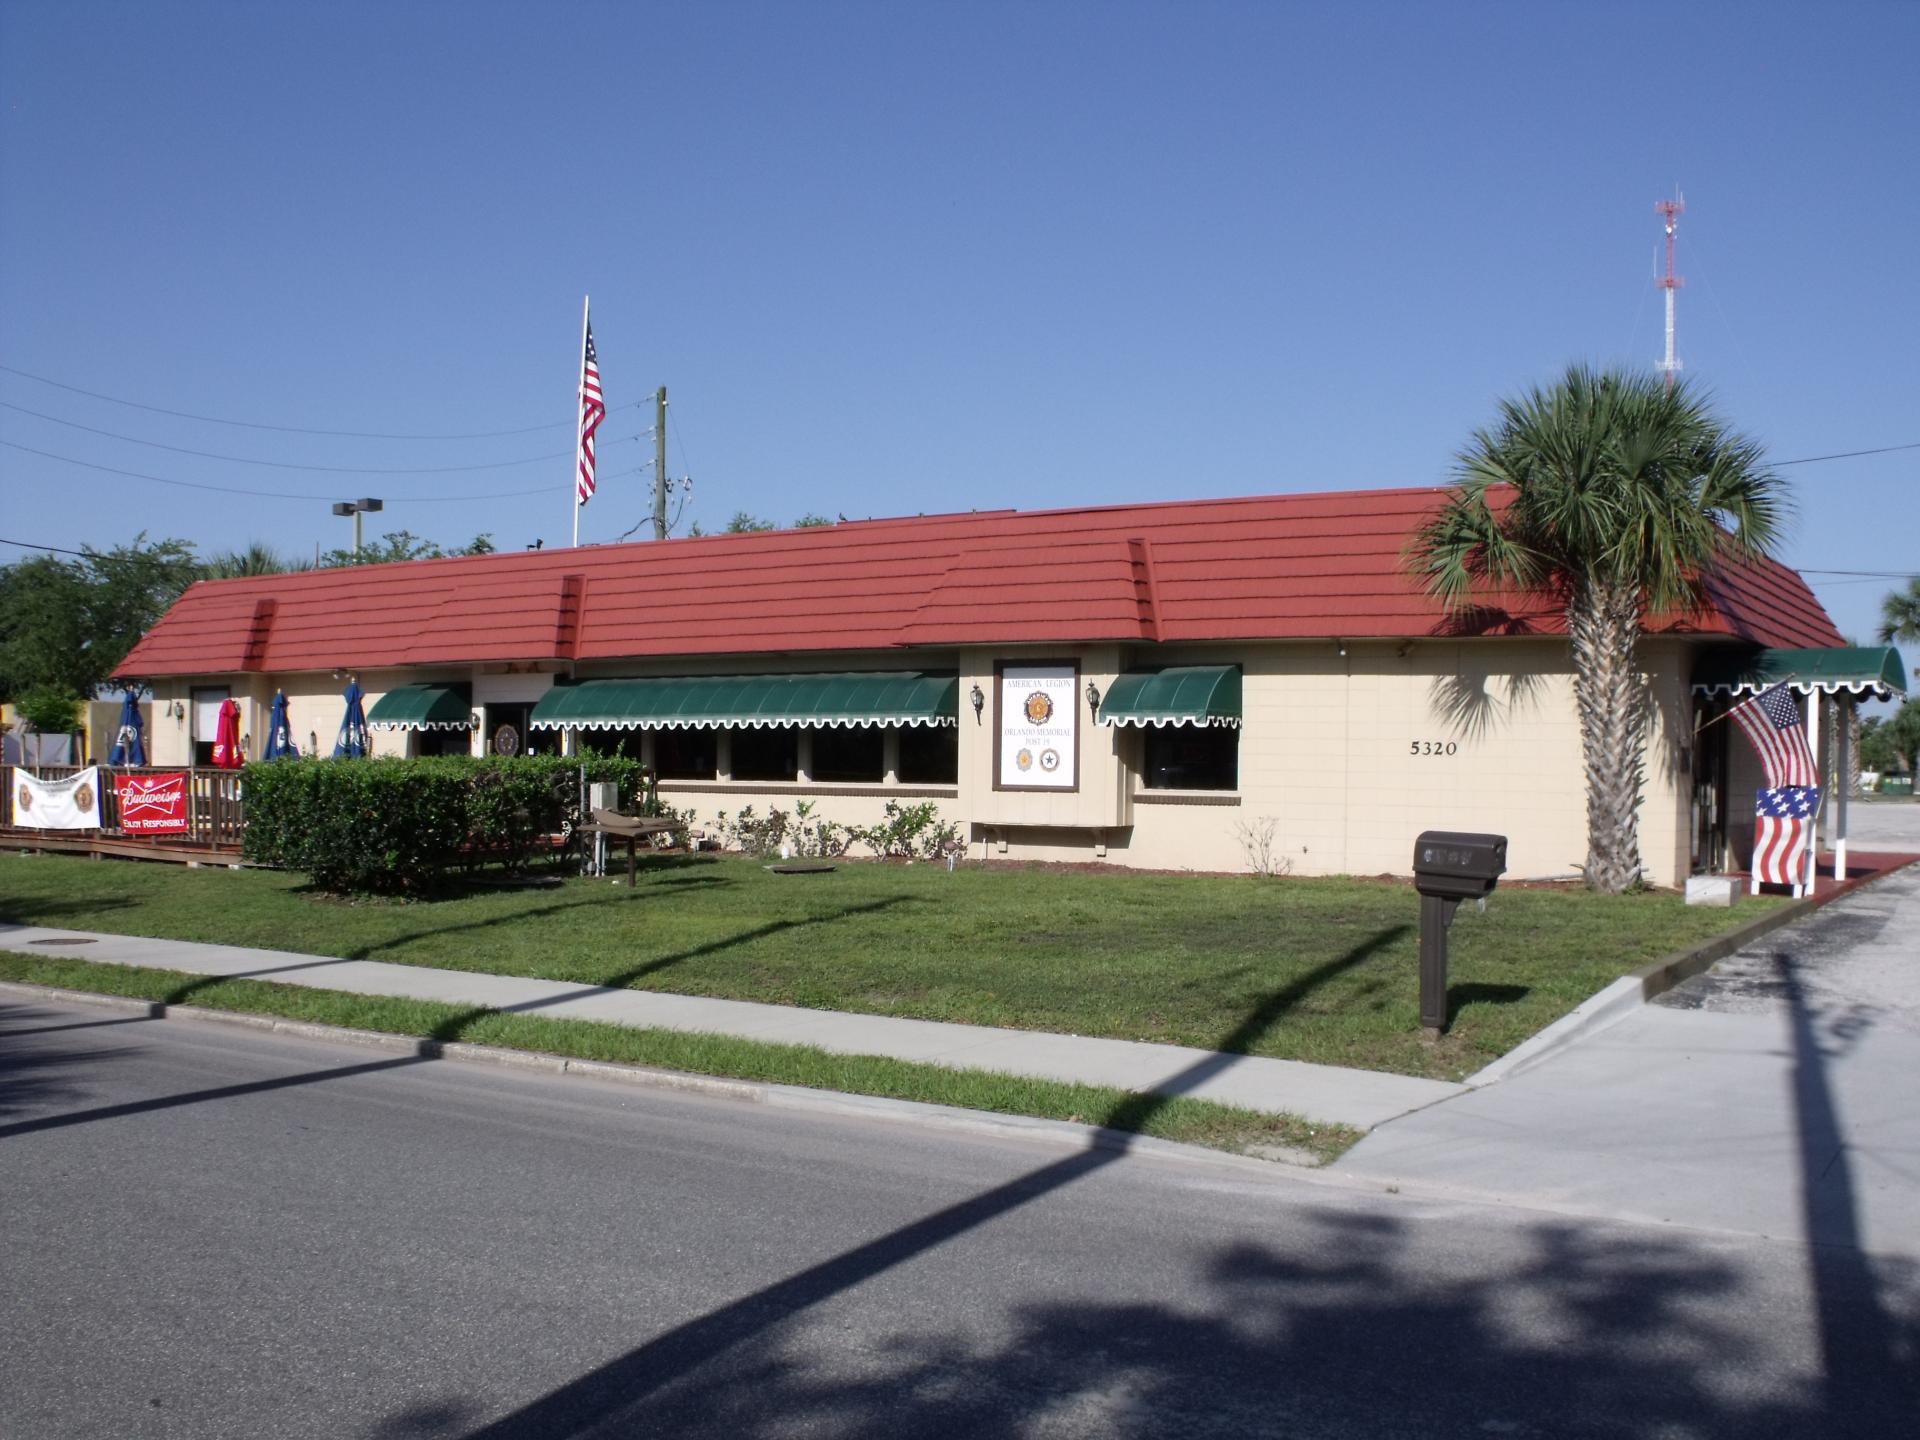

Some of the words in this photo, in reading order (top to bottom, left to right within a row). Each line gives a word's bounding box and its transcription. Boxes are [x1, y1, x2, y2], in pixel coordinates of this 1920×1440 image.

[1007, 680, 1042, 688] AMERICAN
[1046, 680, 1071, 688] LEGION
[1004, 728, 1035, 737] ORLANDO
[1036, 728, 1071, 737] MEMORIAL
[1025, 738, 1041, 746] POST
[1410, 741, 1457, 755] 5320
[120, 788, 181, 805] Budweiser
